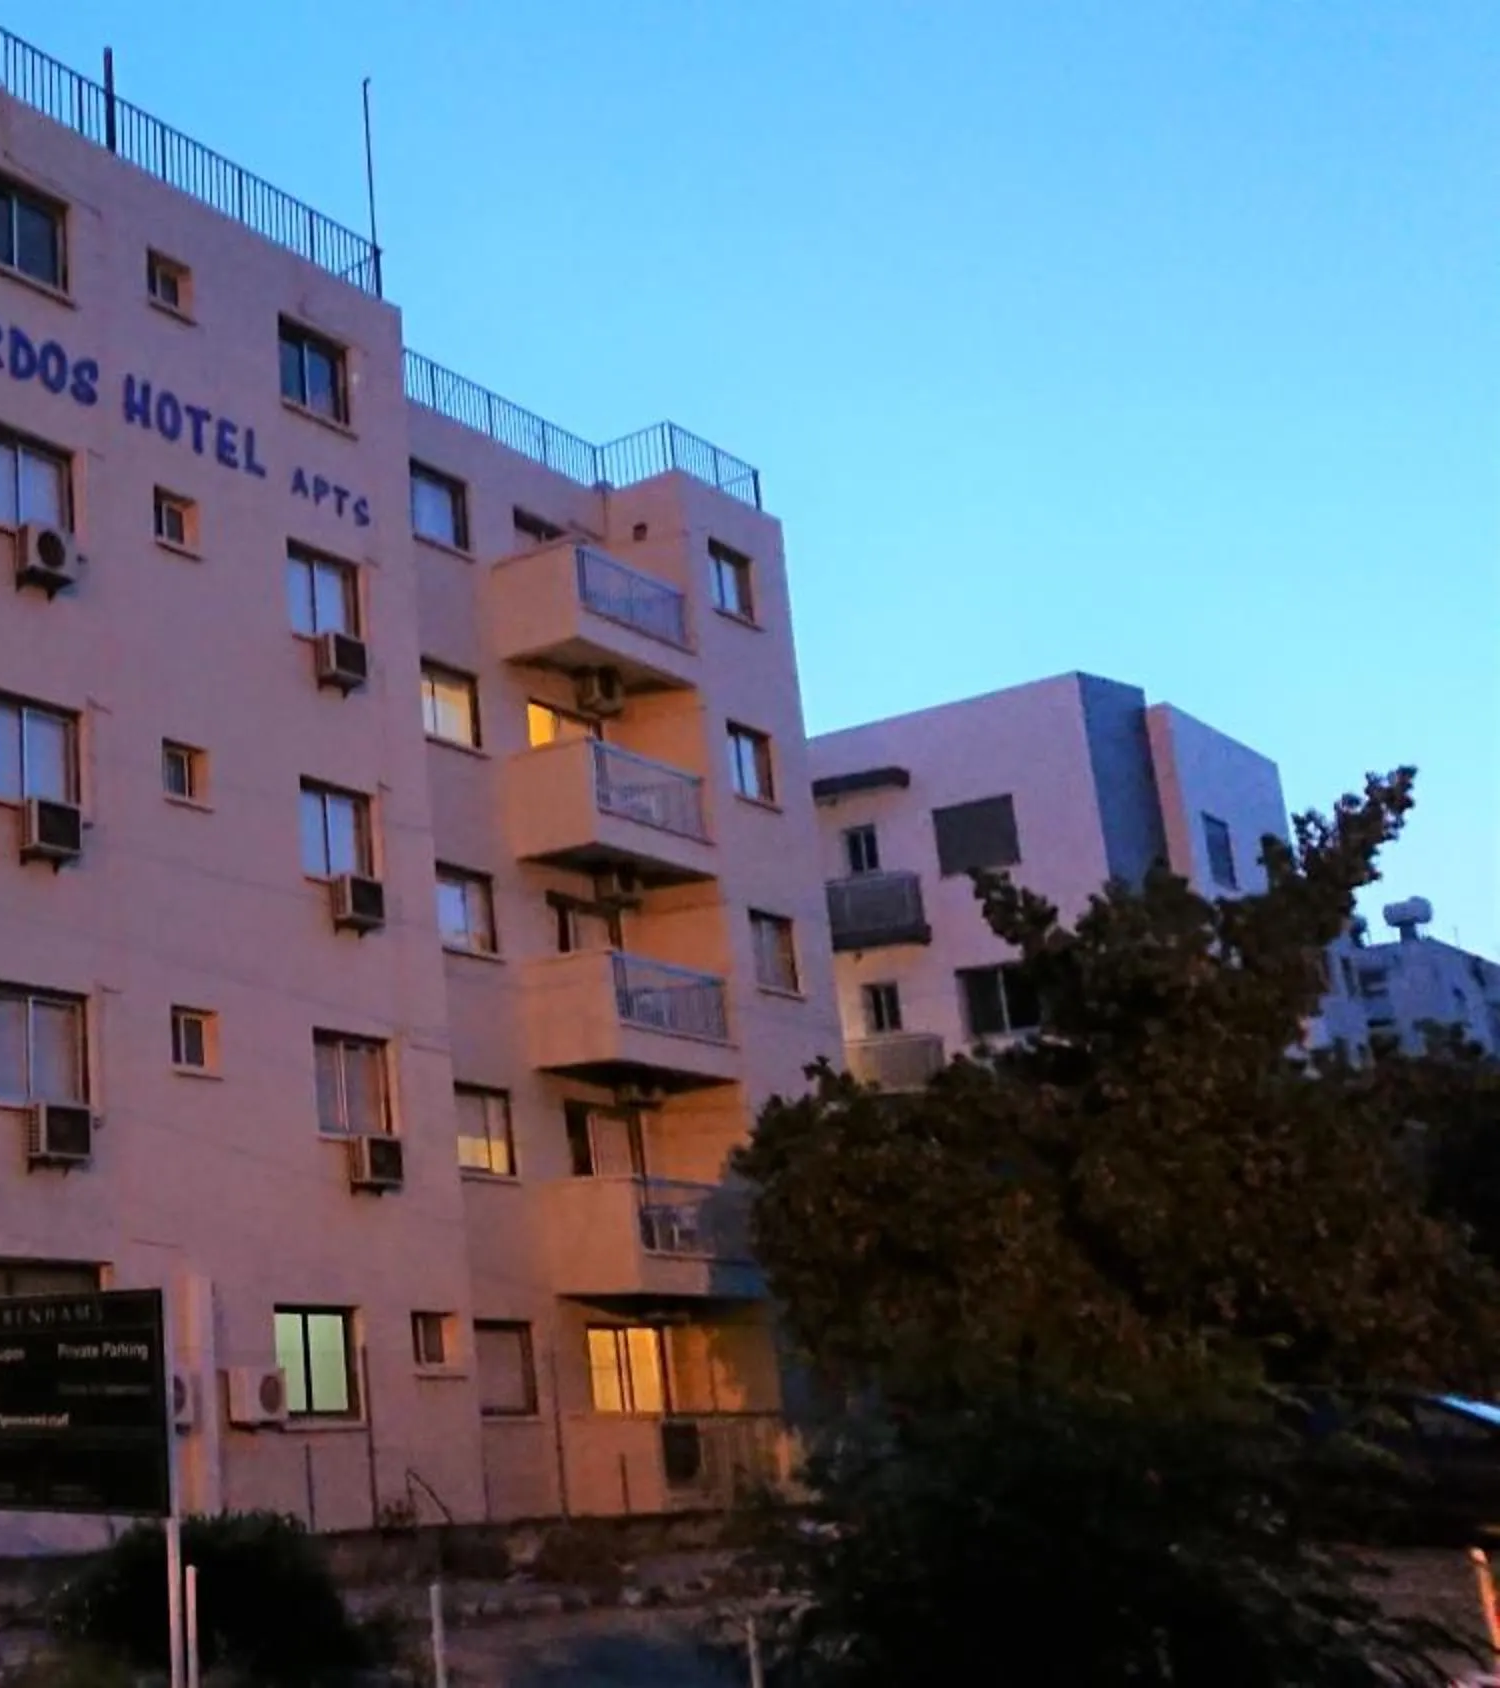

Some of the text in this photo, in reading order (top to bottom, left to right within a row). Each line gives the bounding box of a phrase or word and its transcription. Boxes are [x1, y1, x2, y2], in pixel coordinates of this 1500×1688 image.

[123, 373, 267, 479] HOTEL
[291, 466, 372, 528] APTS
[57, 1341, 149, 1361] Private Parking
